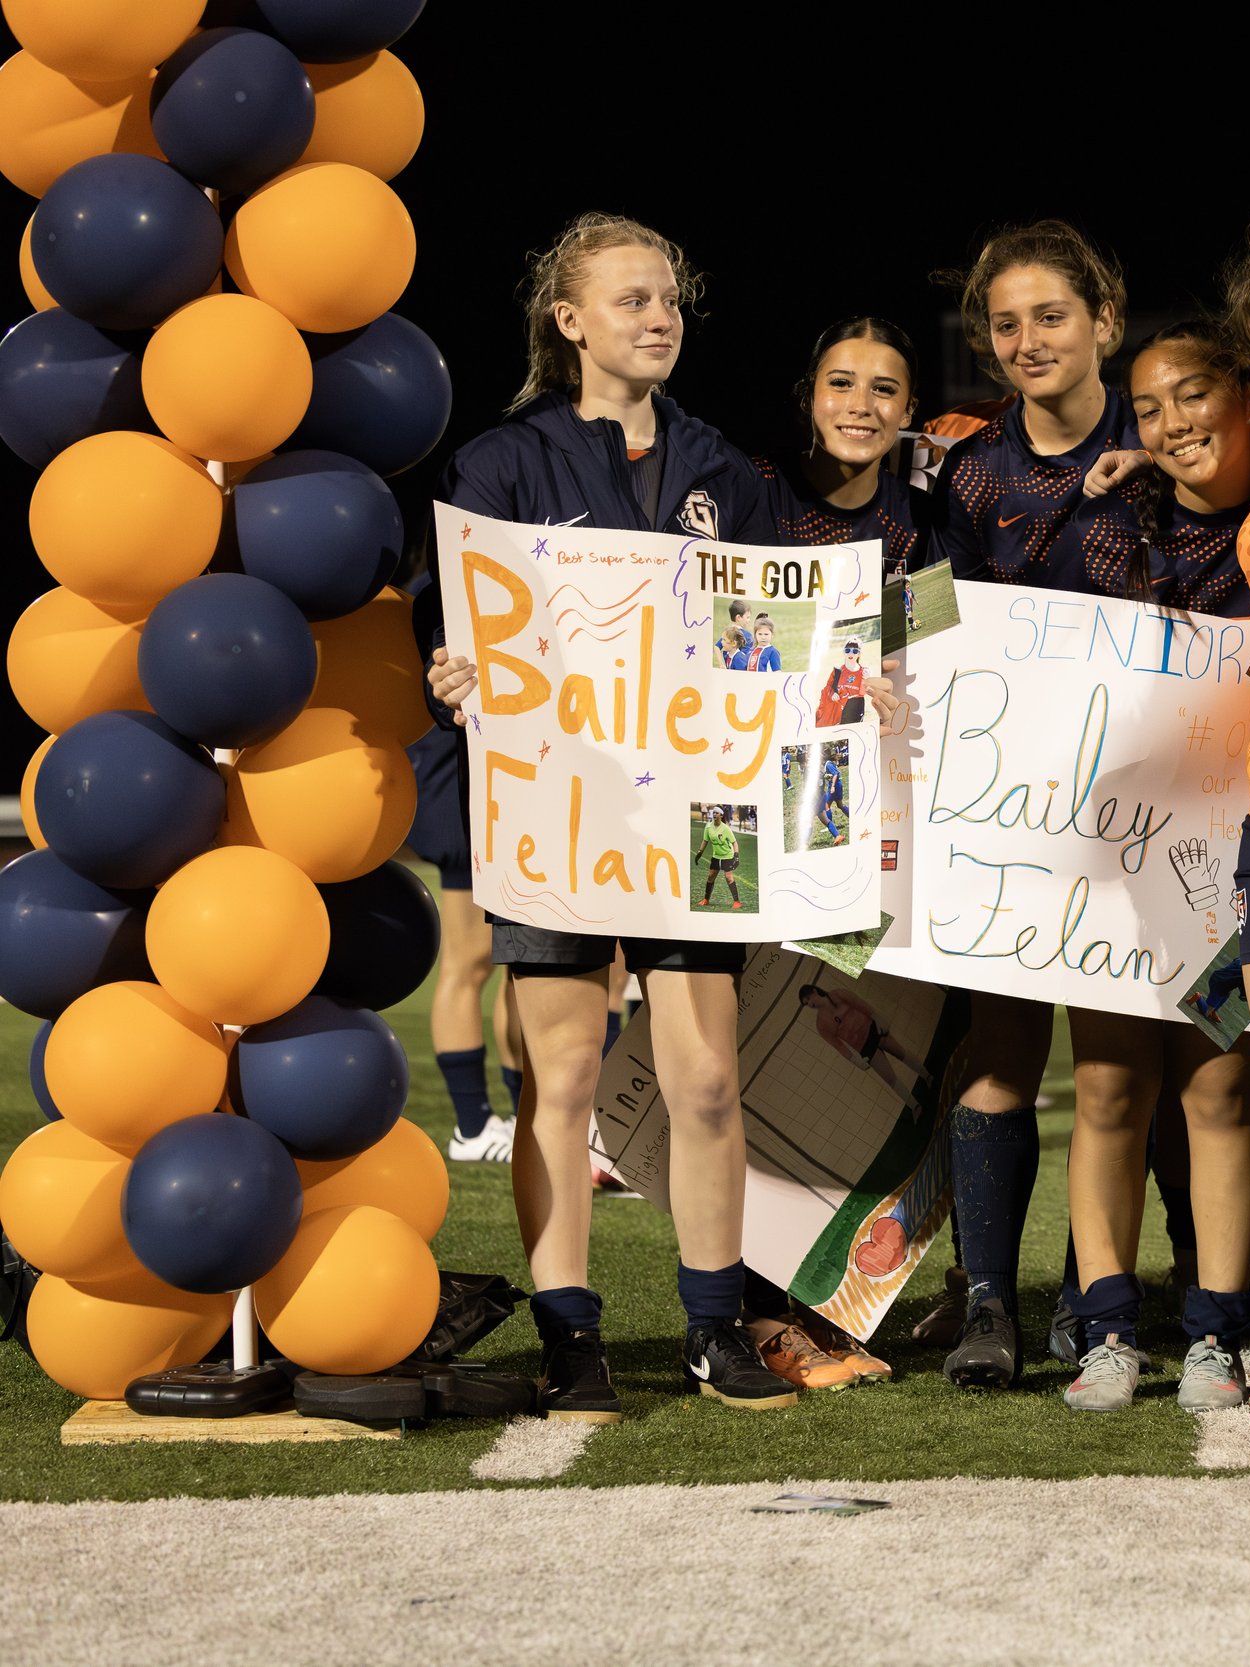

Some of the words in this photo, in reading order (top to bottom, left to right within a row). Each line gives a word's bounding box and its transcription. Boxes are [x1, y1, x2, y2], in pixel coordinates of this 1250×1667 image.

[557, 551, 584, 565] Best
[590, 551, 624, 566] Super
[630, 552, 669, 566] Senior
[696, 551, 747, 596] THE
[760, 556, 847, 600] GOA
[461, 550, 777, 790] Bailey
[1004, 597, 1244, 684] SENIOR
[485, 750, 681, 898] Felan
[926, 668, 1172, 874] Bailey
[1202, 774, 1236, 795] our
[928, 844, 1185, 986] Felan
